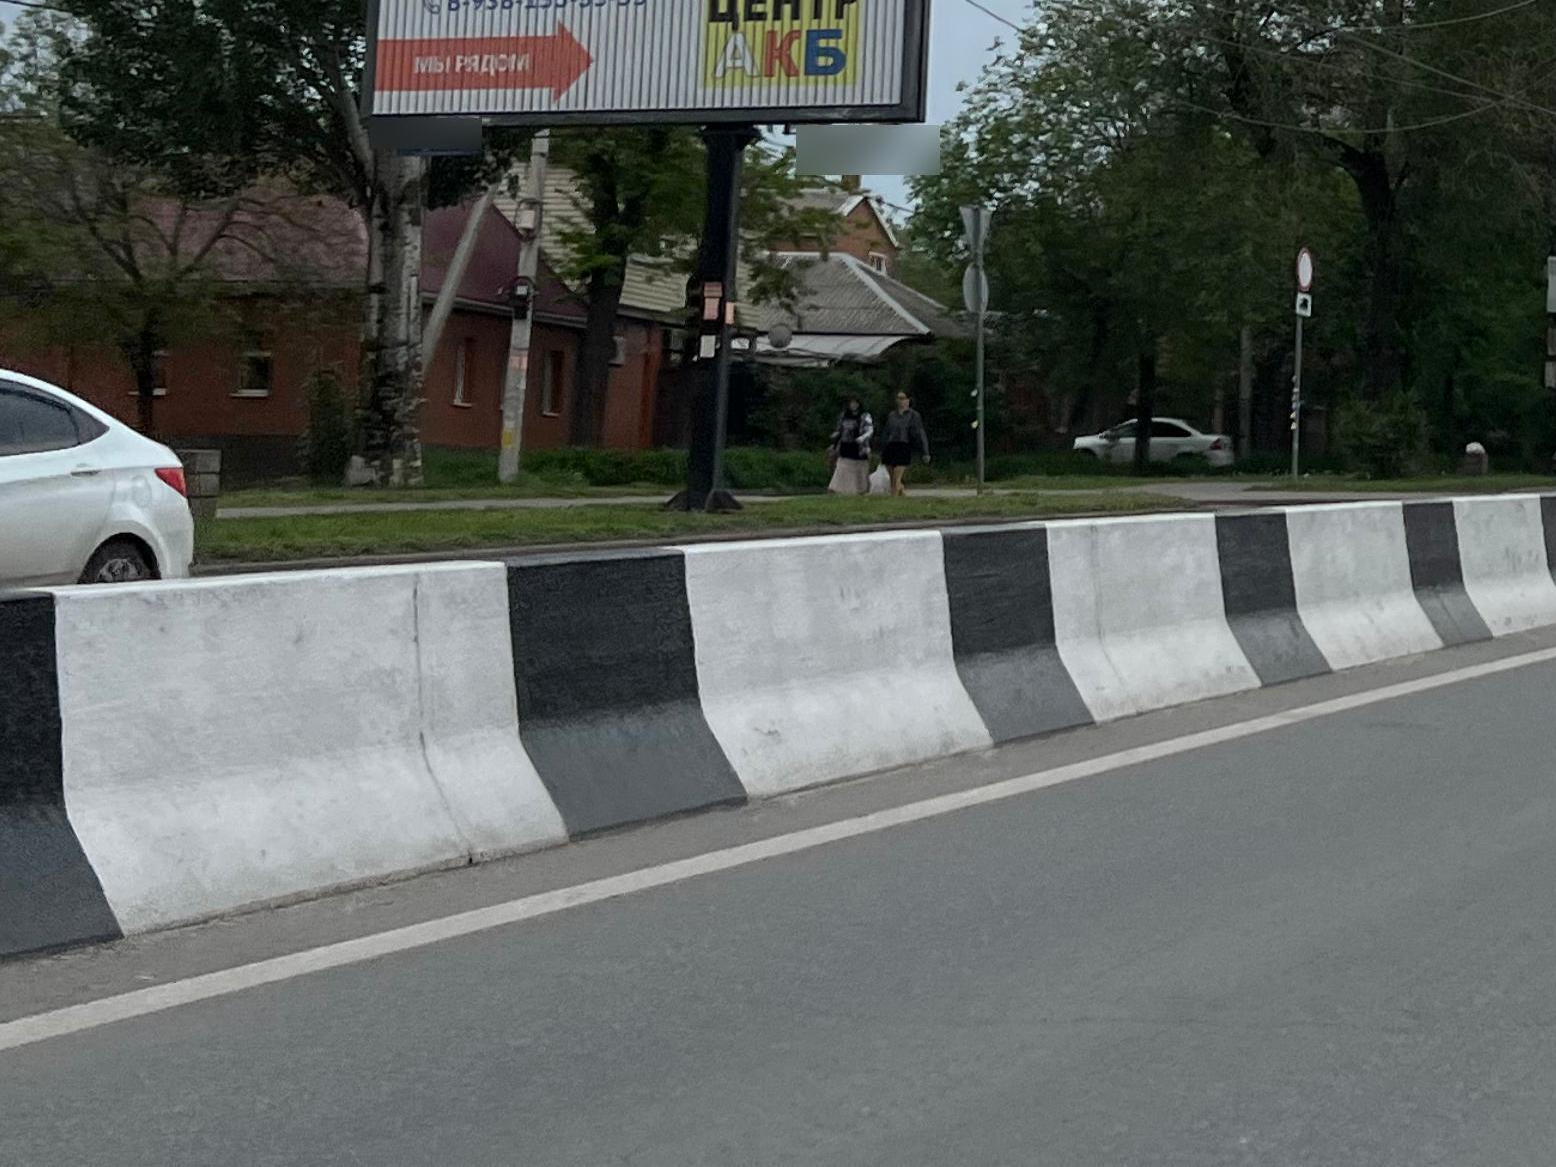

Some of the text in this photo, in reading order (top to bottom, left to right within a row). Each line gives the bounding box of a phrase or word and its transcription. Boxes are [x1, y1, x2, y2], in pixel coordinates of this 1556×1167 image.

[414, 52, 530, 76] МЫ РЯДОМ
[713, 28, 848, 79] АКБ
